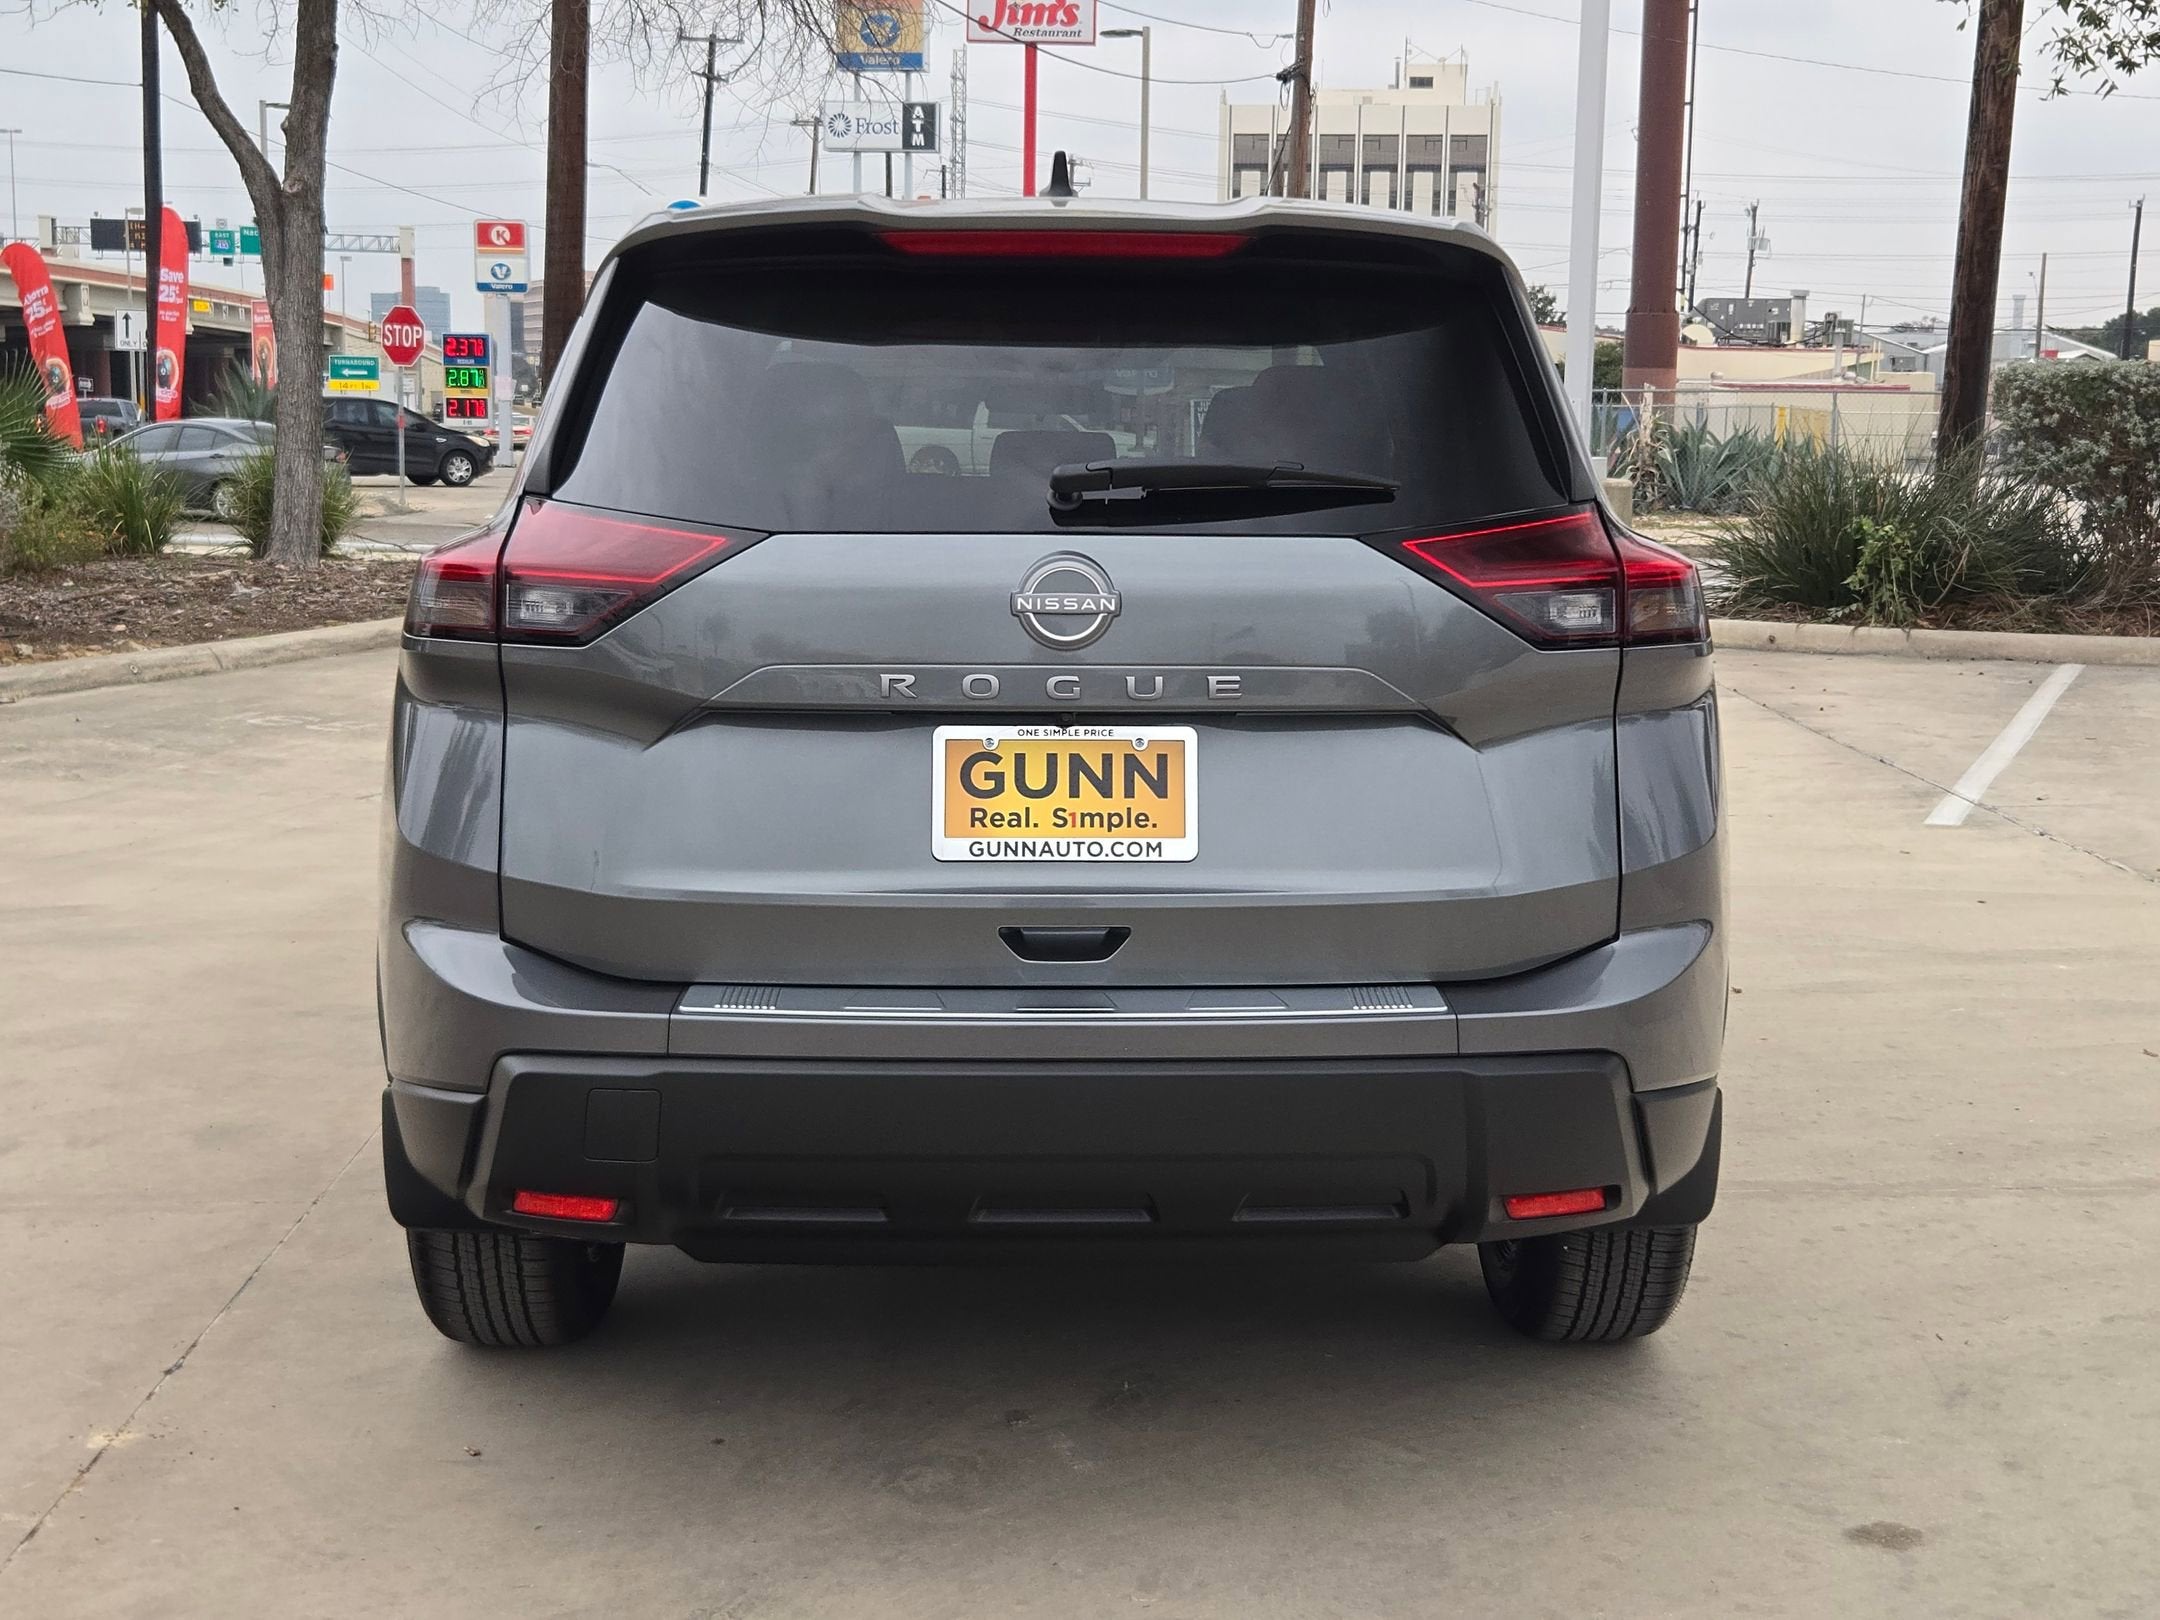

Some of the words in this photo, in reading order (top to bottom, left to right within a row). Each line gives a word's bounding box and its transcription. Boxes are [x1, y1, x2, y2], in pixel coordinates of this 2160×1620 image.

[978, 0, 1080, 33] Jim's
[1013, 27, 1083, 38] Restaurant
[855, 118, 900, 136] Frost
[911, 105, 925, 147] ATM
[159, 267, 185, 284] Save
[383, 324, 423, 348] STOP
[1016, 597, 1116, 612] NISSAN
[880, 673, 1243, 701] ROGUE
[1017, 728, 1040, 737] ONE
[1043, 728, 1080, 738] SIMPLE
[1083, 728, 1115, 738] PRICE
[959, 751, 1169, 799] GUNN
[969, 806, 1039, 829] Real.
[969, 840, 1163, 858] GUNNAUTO.COM
